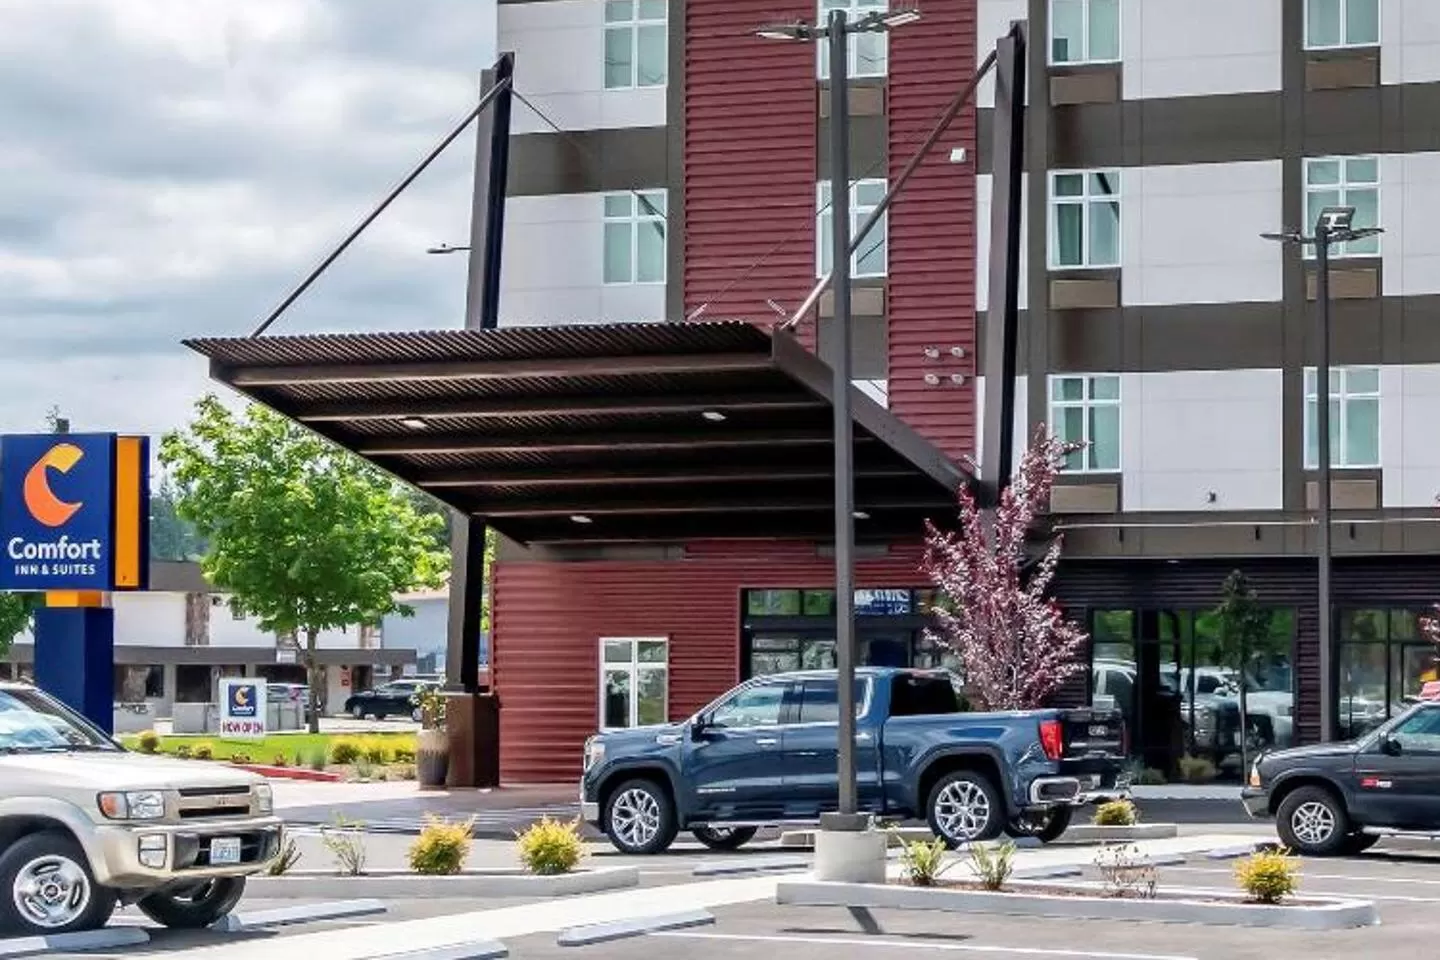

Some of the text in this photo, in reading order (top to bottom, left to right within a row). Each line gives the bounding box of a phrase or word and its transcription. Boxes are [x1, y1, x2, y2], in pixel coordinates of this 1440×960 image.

[8, 535, 101, 559] Comfort
[15, 564, 95, 575] INN & SUITES
